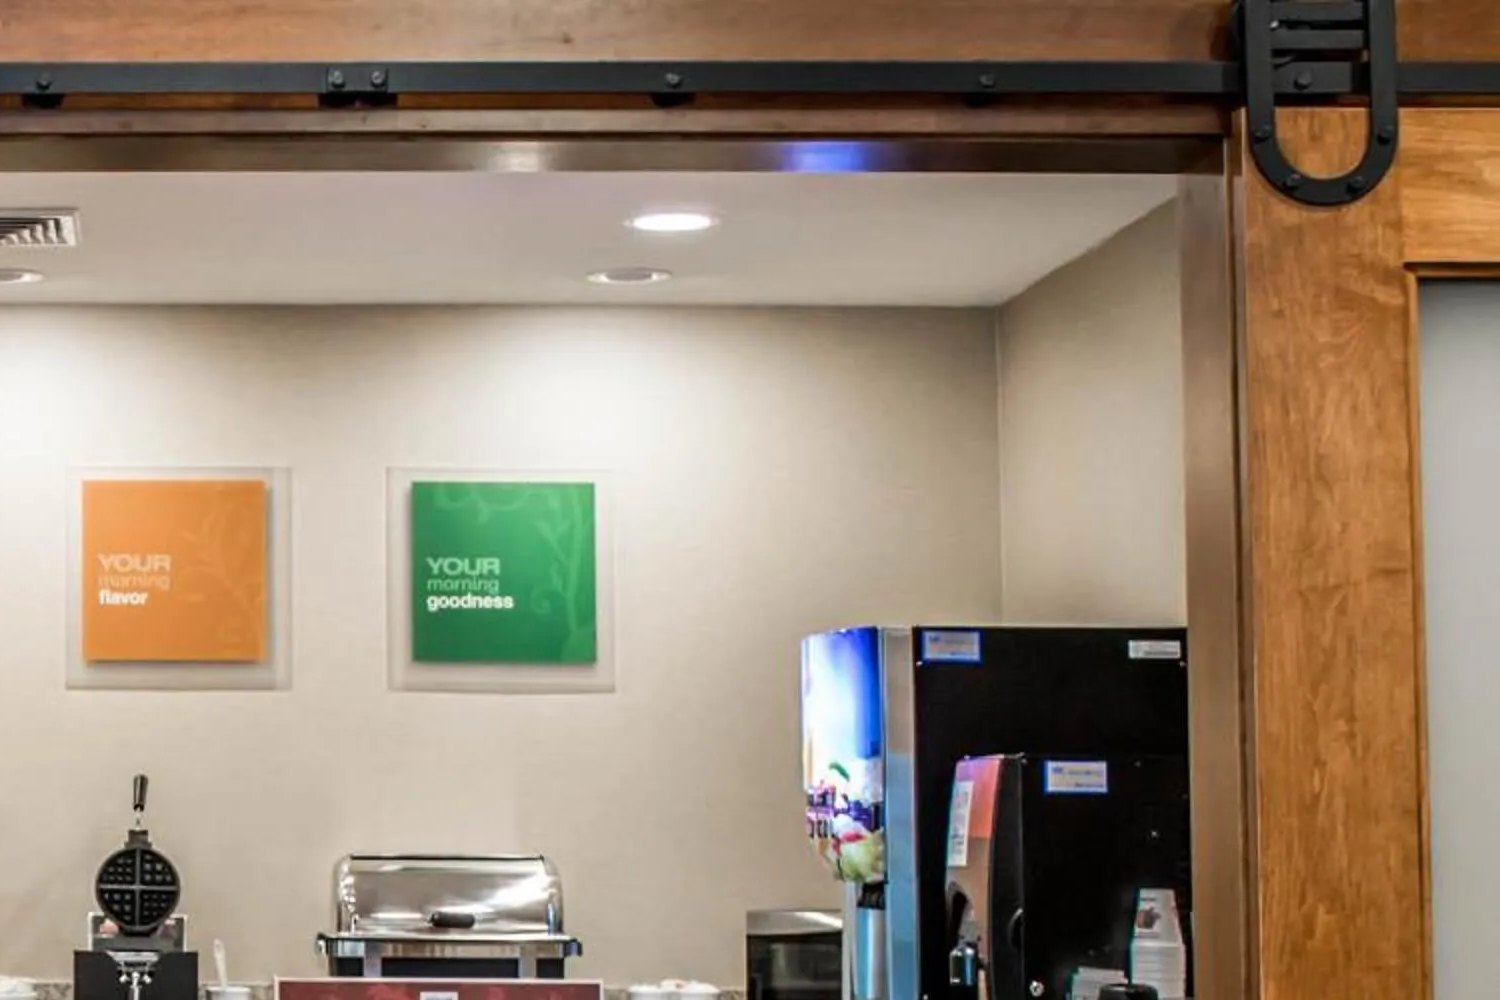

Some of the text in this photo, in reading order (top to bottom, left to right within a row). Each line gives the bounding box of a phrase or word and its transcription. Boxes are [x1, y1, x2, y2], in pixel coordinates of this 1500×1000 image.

[97, 553, 171, 573] YOUR
[426, 557, 500, 576] YOUR
[98, 573, 170, 591] morning
[427, 576, 500, 595] morning
[99, 588, 148, 605] flavor
[427, 592, 514, 613] goodness
